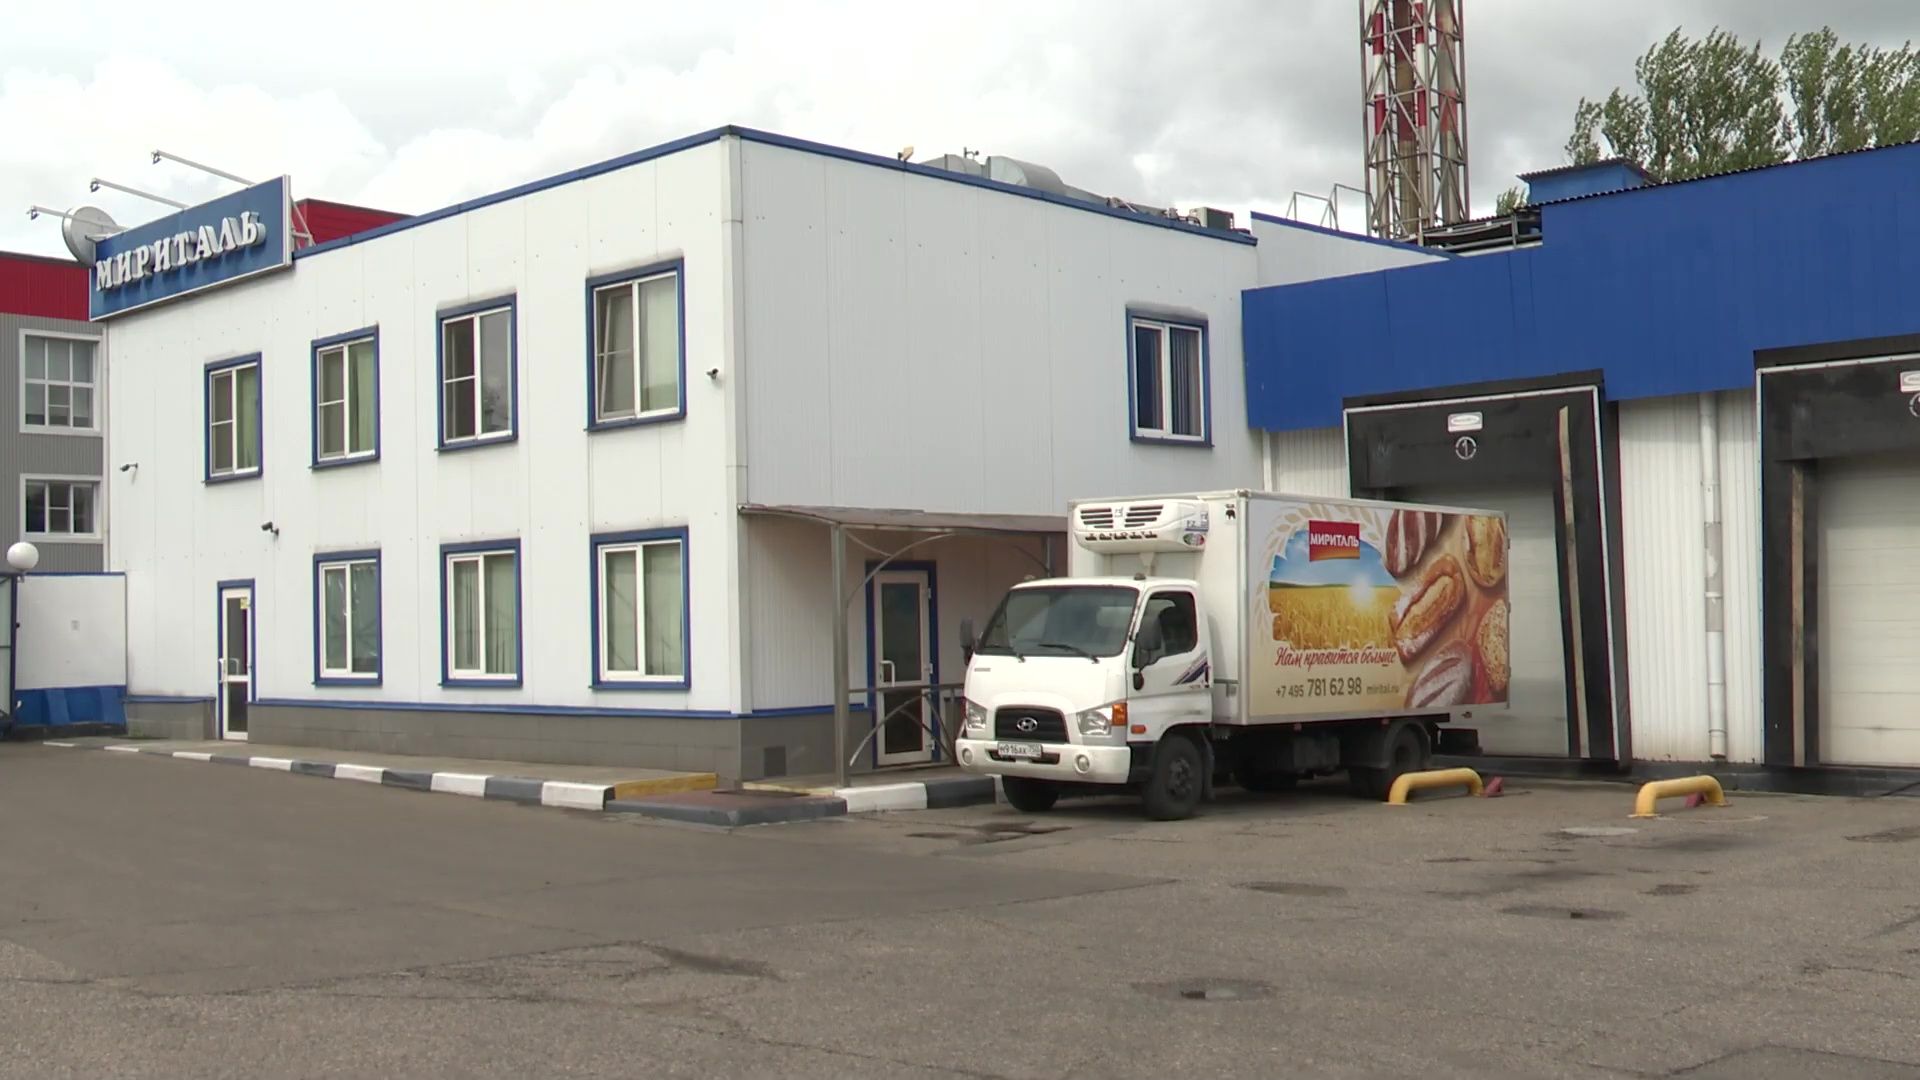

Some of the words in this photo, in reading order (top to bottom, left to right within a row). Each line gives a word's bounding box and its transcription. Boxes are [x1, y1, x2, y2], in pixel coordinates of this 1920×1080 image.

[96, 211, 265, 291] МИРИТАЛЬ
[1310, 533, 1360, 548] МИРИТАЛЬ
[1275, 647, 1303, 668] Нам
[1304, 649, 1359, 672] нравится
[1360, 646, 1397, 667] больше
[1276, 685, 1287, 698] +7
[1288, 684, 1304, 698] 495
[1307, 678, 1327, 697] 781
[1329, 677, 1345, 696] 62
[1347, 677, 1362, 696] 98
[1366, 683, 1399, 695] mirital.ru
